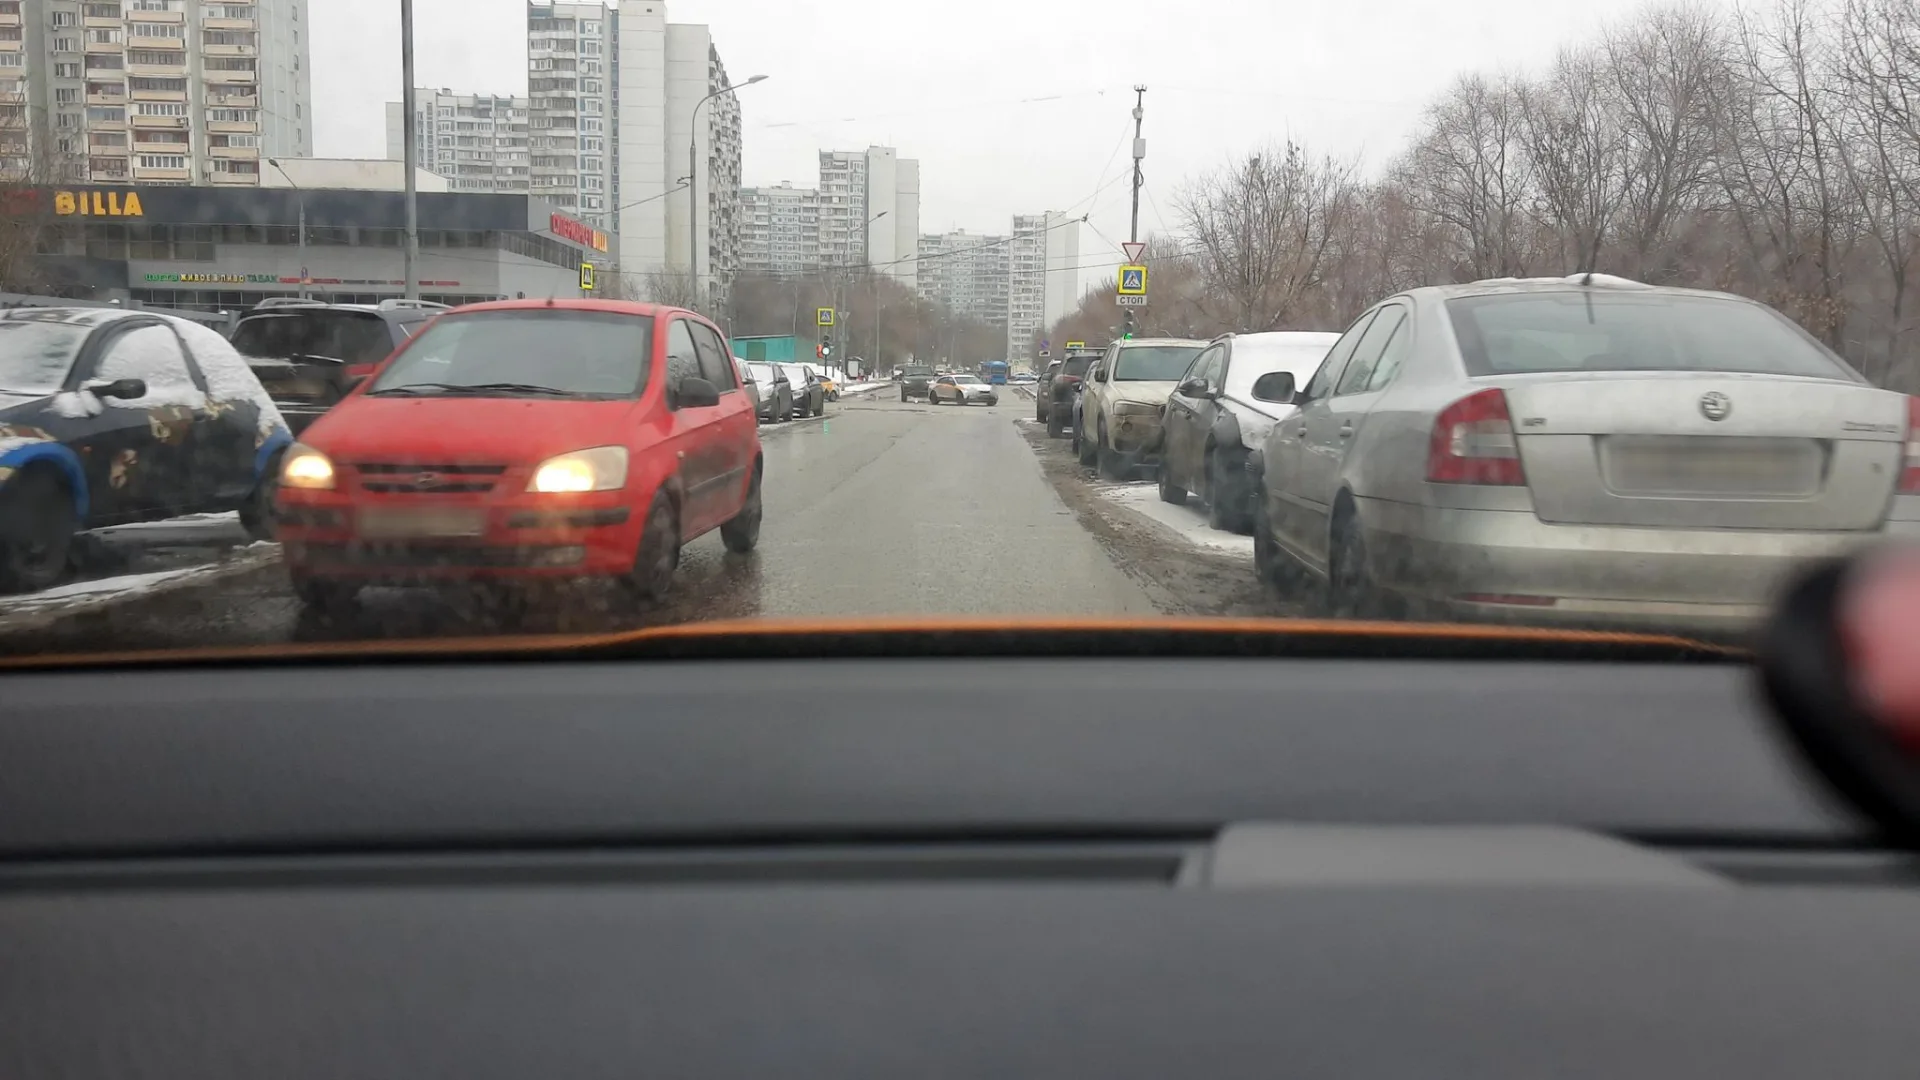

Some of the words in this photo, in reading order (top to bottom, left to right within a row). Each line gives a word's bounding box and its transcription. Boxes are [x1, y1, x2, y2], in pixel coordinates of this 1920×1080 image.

[55, 190, 143, 216] BILLA
[180, 273, 211, 282] ЖИВОЕ
[220, 273, 245, 283] ПИВО
[1120, 296, 1143, 304] СТОП
